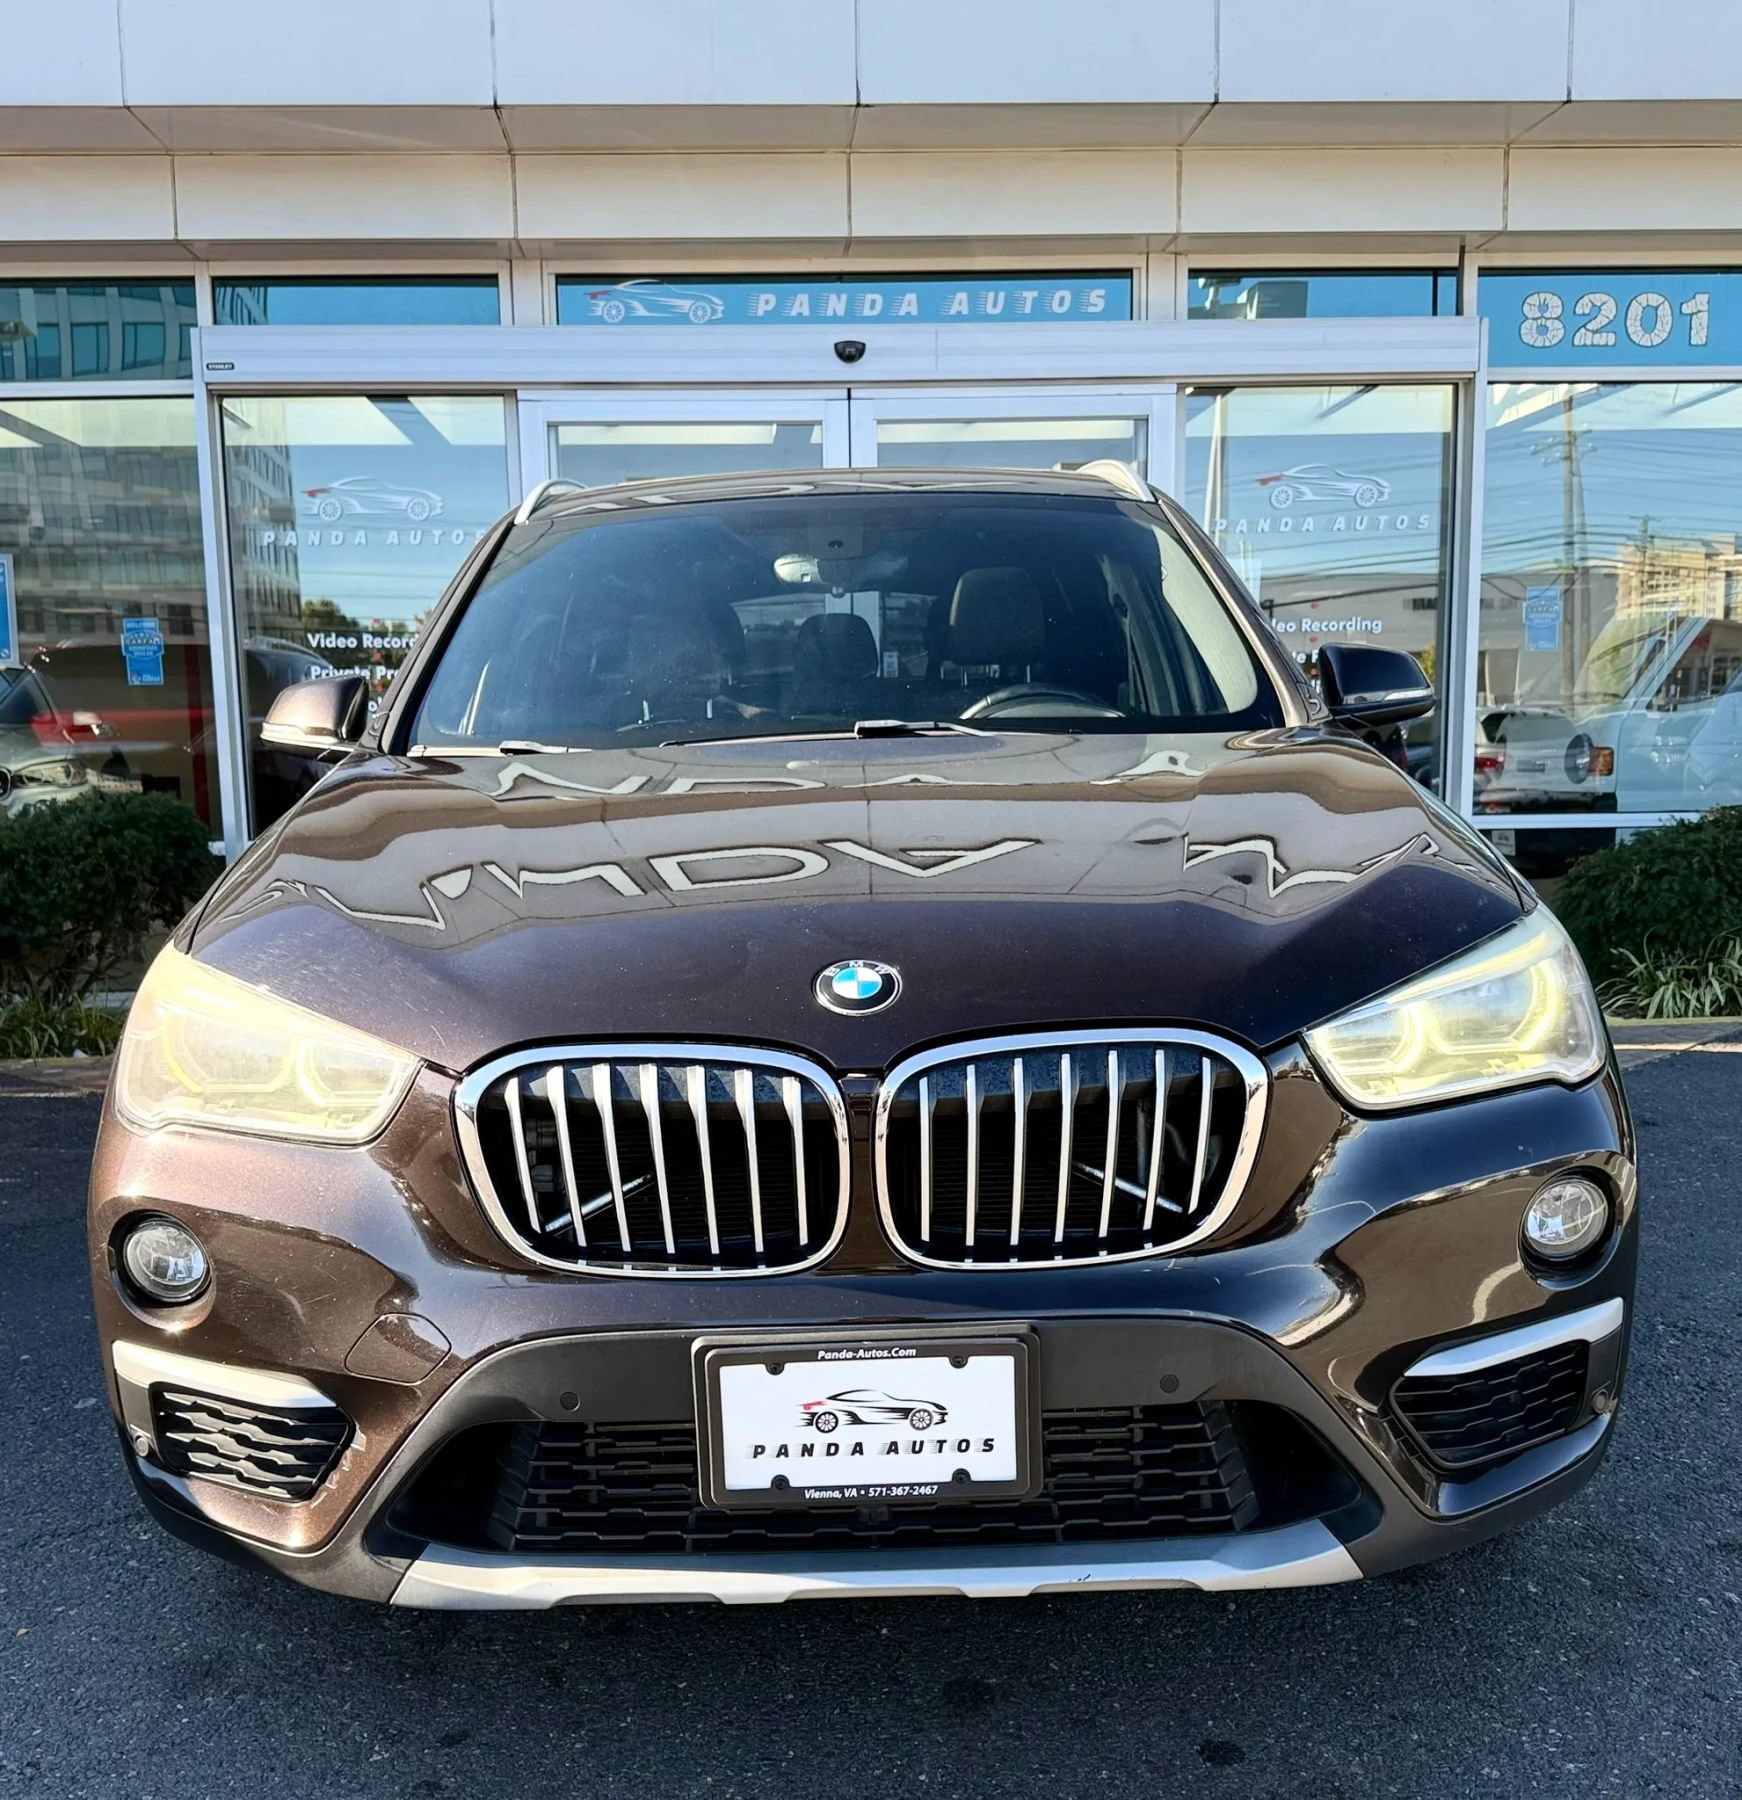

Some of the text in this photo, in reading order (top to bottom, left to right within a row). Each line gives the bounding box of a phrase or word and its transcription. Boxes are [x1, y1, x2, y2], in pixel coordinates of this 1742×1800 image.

[748, 288, 1106, 317] PANDA AUTOS
[1519, 291, 1711, 348] 8201
[1214, 514, 1431, 534] PANDA AUTOS
[262, 530, 368, 547] PANDA
[1301, 616, 1383, 634] Recording
[307, 632, 358, 649] Video
[823, 960, 892, 977] BMW
[817, 1347, 917, 1360] Panda-Autos.Com
[748, 1438, 996, 1459] PANDA AUTOS
[804, 1485, 938, 1499] Vienna, VA 571-367-2467
